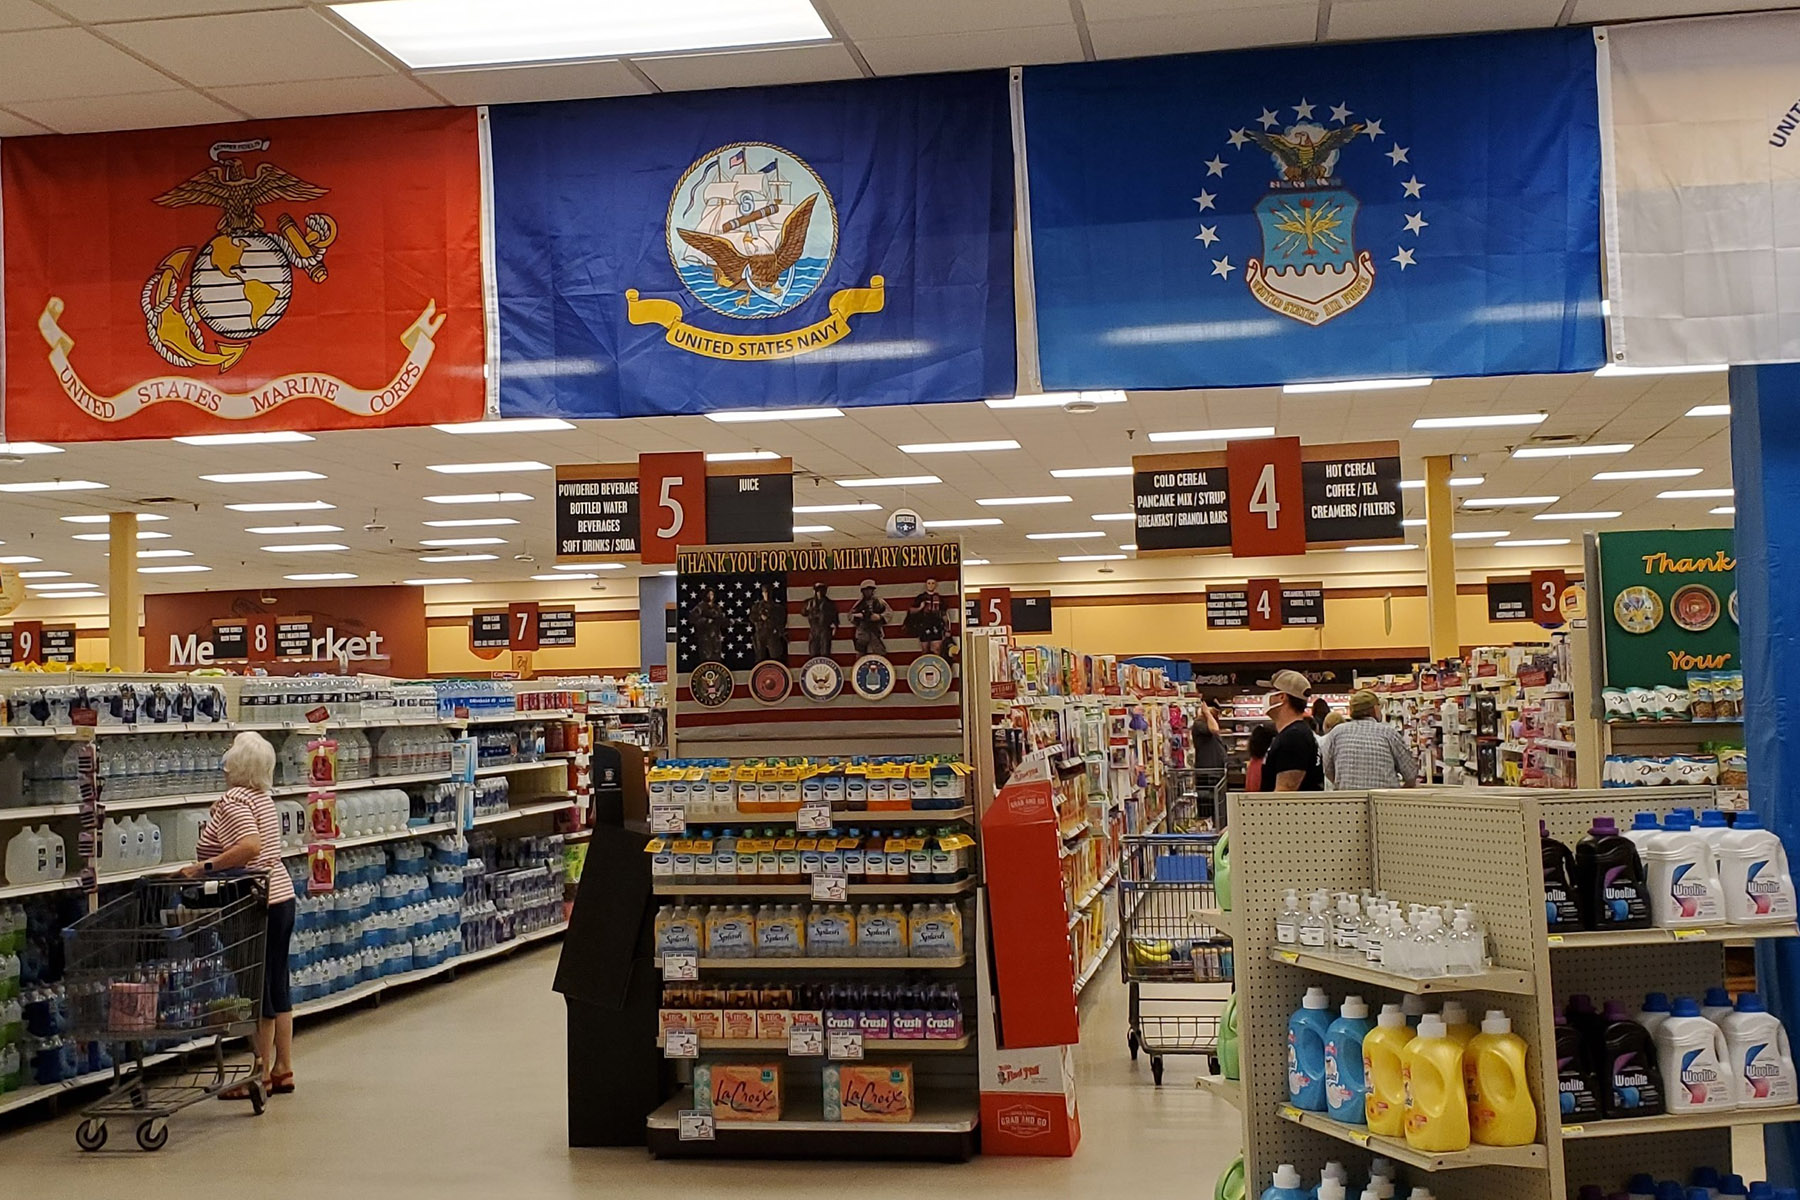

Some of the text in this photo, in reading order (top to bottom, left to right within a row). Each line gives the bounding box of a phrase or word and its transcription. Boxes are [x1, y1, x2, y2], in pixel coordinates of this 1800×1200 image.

[1769, 98, 1800, 148] UNIT
[675, 320, 840, 356] UNITED STATES NAVY
[59, 361, 420, 418] UNITED STATES MARINE CORPS
[1326, 462, 1377, 478] HOT CEREAL
[739, 478, 760, 493] JUICE
[1154, 472, 1208, 488] COLD CEREAL
[559, 481, 639, 497] POWDERED BEVERAGE
[1249, 464, 1280, 529] 4
[1326, 483, 1356, 497] COFFEE
[1362, 482, 1378, 496] TEA
[656, 476, 684, 539] 5
[1138, 493, 1176, 508] PANCAKE
[1177, 492, 1193, 506] MIX
[1198, 491, 1226, 506] SYRUP
[570, 501, 628, 515] BOTTLED WATER
[1311, 504, 1357, 519] CREAMERS
[1363, 501, 1396, 516] FILTERS
[577, 519, 621, 533] BEVERAGES
[1138, 513, 1174, 528] BREAKFAST
[1178, 511, 1209, 526] GRANOLA
[1209, 510, 1228, 525] BARS
[562, 539, 580, 553] SOFT
[582, 539, 610, 552] DRINKS
[615, 538, 636, 551] SODA
[679, 543, 959, 574] THANK YOU FOR YOUR MILITARY SERVICE
[1642, 551, 1736, 575] Thank
[1256, 590, 1271, 619] 4
[1541, 581, 1556, 612] 3
[988, 599, 1002, 626] 5
[516, 613, 528, 641] 7
[20, 631, 32, 658] 9
[255, 624, 267, 652] 8
[1667, 650, 1732, 671] Your
[1605, 887, 1636, 899] Woolite
[1673, 883, 1707, 897] Woolite
[1748, 881, 1780, 894] Woolite
[826, 1017, 855, 1028] Crush
[860, 1017, 887, 1028] Crush
[893, 1017, 921, 1028] Crush
[926, 1017, 955, 1028] Crush
[1682, 1069, 1717, 1083] Woolite
[1746, 1064, 1780, 1078] Woolite
[1558, 1078, 1584, 1091] oolite
[1614, 1074, 1648, 1087] Woolite
